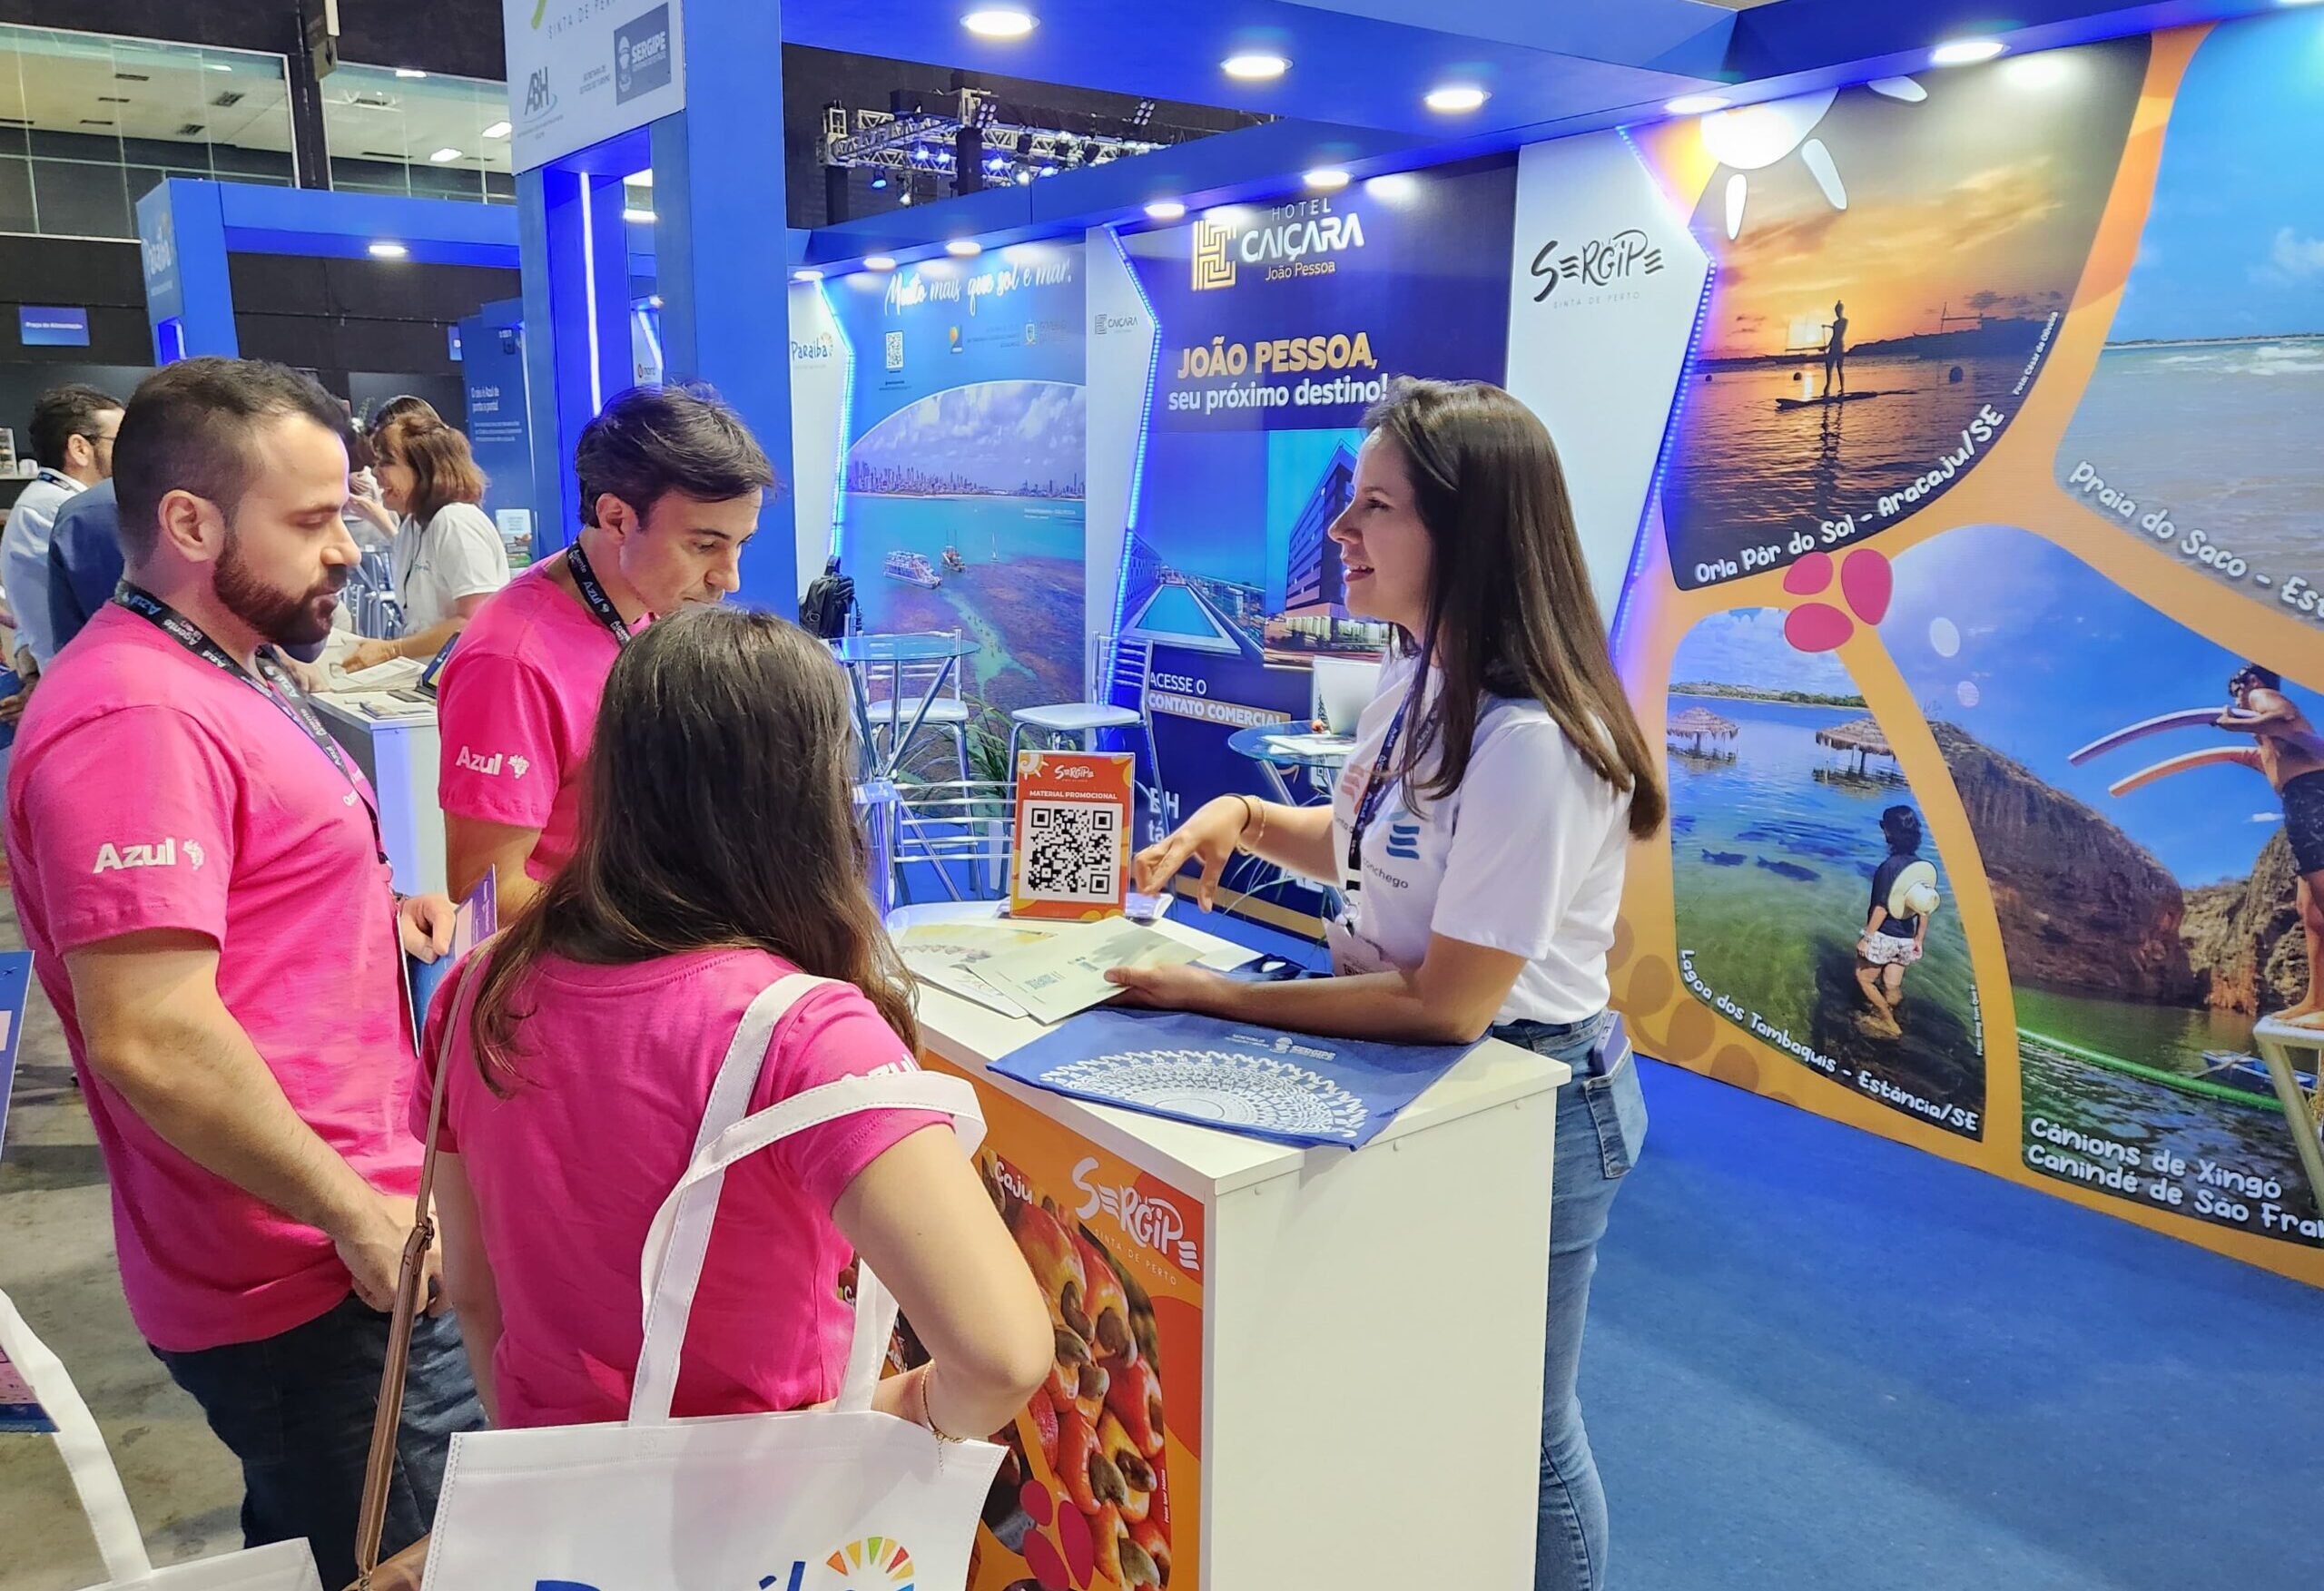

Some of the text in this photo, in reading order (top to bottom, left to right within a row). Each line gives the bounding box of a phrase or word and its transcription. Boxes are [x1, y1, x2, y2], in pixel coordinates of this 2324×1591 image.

[632, 32, 666, 64] SERGIPE
[1272, 198, 1332, 221] HOTEL
[1241, 212, 1364, 263] CAIÇARA
[1265, 260, 1335, 281] João Pessoa
[930, 280, 960, 301] mais
[968, 277, 993, 316] que
[997, 261, 1019, 296] sol
[1023, 269, 1031, 287] e
[1554, 291, 1640, 309] SINTA DE PERTO
[1177, 332, 1378, 378] JOÃO PESSOA,
[2036, 341, 2045, 353] de
[1169, 373, 1389, 415] seu próximo destino!
[1695, 558, 1738, 583] Orla
[1741, 545, 1781, 570] Pôr
[1788, 532, 1815, 555] do
[1821, 515, 1856, 543] Sol
[1877, 404, 2004, 517] Aracaju/SE
[2069, 461, 2136, 517] Praia
[2142, 509, 2175, 538] do
[2181, 529, 2247, 576] Saco
[129, 592, 162, 615] Azul
[583, 581, 605, 604] Azul
[163, 619, 197, 646] Agente
[274, 676, 300, 698] Azul
[1149, 672, 1207, 695] ACESSE O
[1148, 693, 1204, 716] CONTATO
[456, 745, 503, 775] Azul
[1065, 791, 1118, 800] PROMOCIONAL
[93, 837, 176, 874] Azul
[1681, 949, 1713, 1000] Lagoa
[1716, 995, 1745, 1021] dos
[1748, 1011, 1837, 1073] Tambaquis
[1857, 1070, 1980, 1132] Estância/SE
[2030, 1117, 2282, 1199] Cânions de Xingó
[994, 1161, 1033, 1204] Caju
[2027, 1144, 2139, 1193] Canindé
[2150, 1178, 2182, 1205] de
[2194, 1189, 2250, 1222] São
[1095, 1228, 1177, 1285] SINTA DE PERTO
